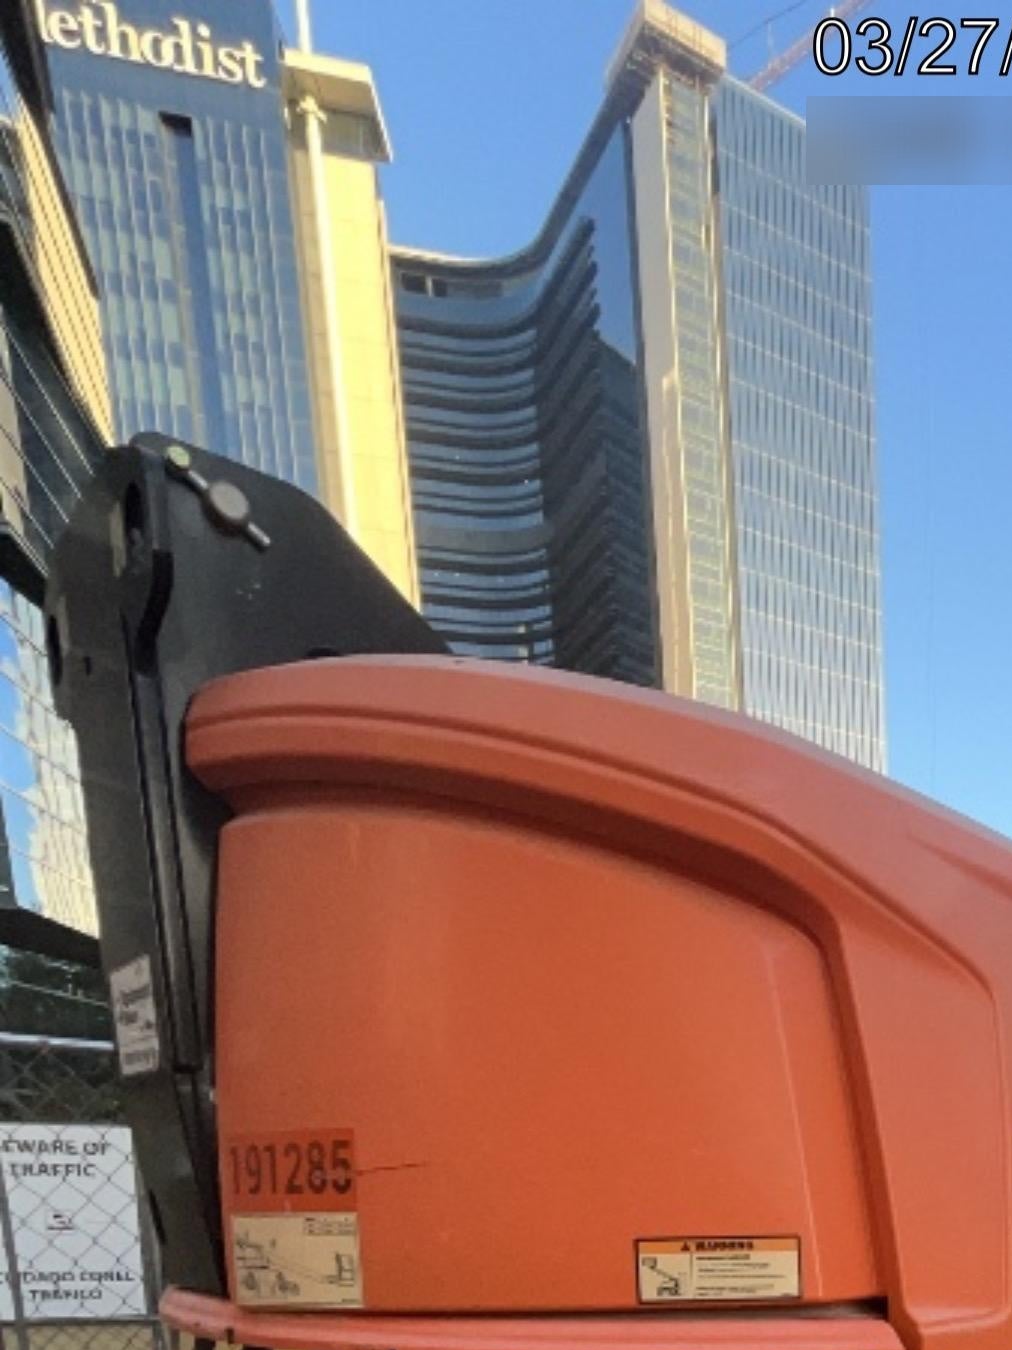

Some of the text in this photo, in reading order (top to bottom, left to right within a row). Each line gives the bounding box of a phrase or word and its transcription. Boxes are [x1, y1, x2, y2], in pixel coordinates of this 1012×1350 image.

[37, 0, 267, 88] ethodist
[0, 1138, 79, 1155] EWARE
[10, 1163, 96, 1177] TRAFFIC
[231, 1139, 352, 1195] 191285
